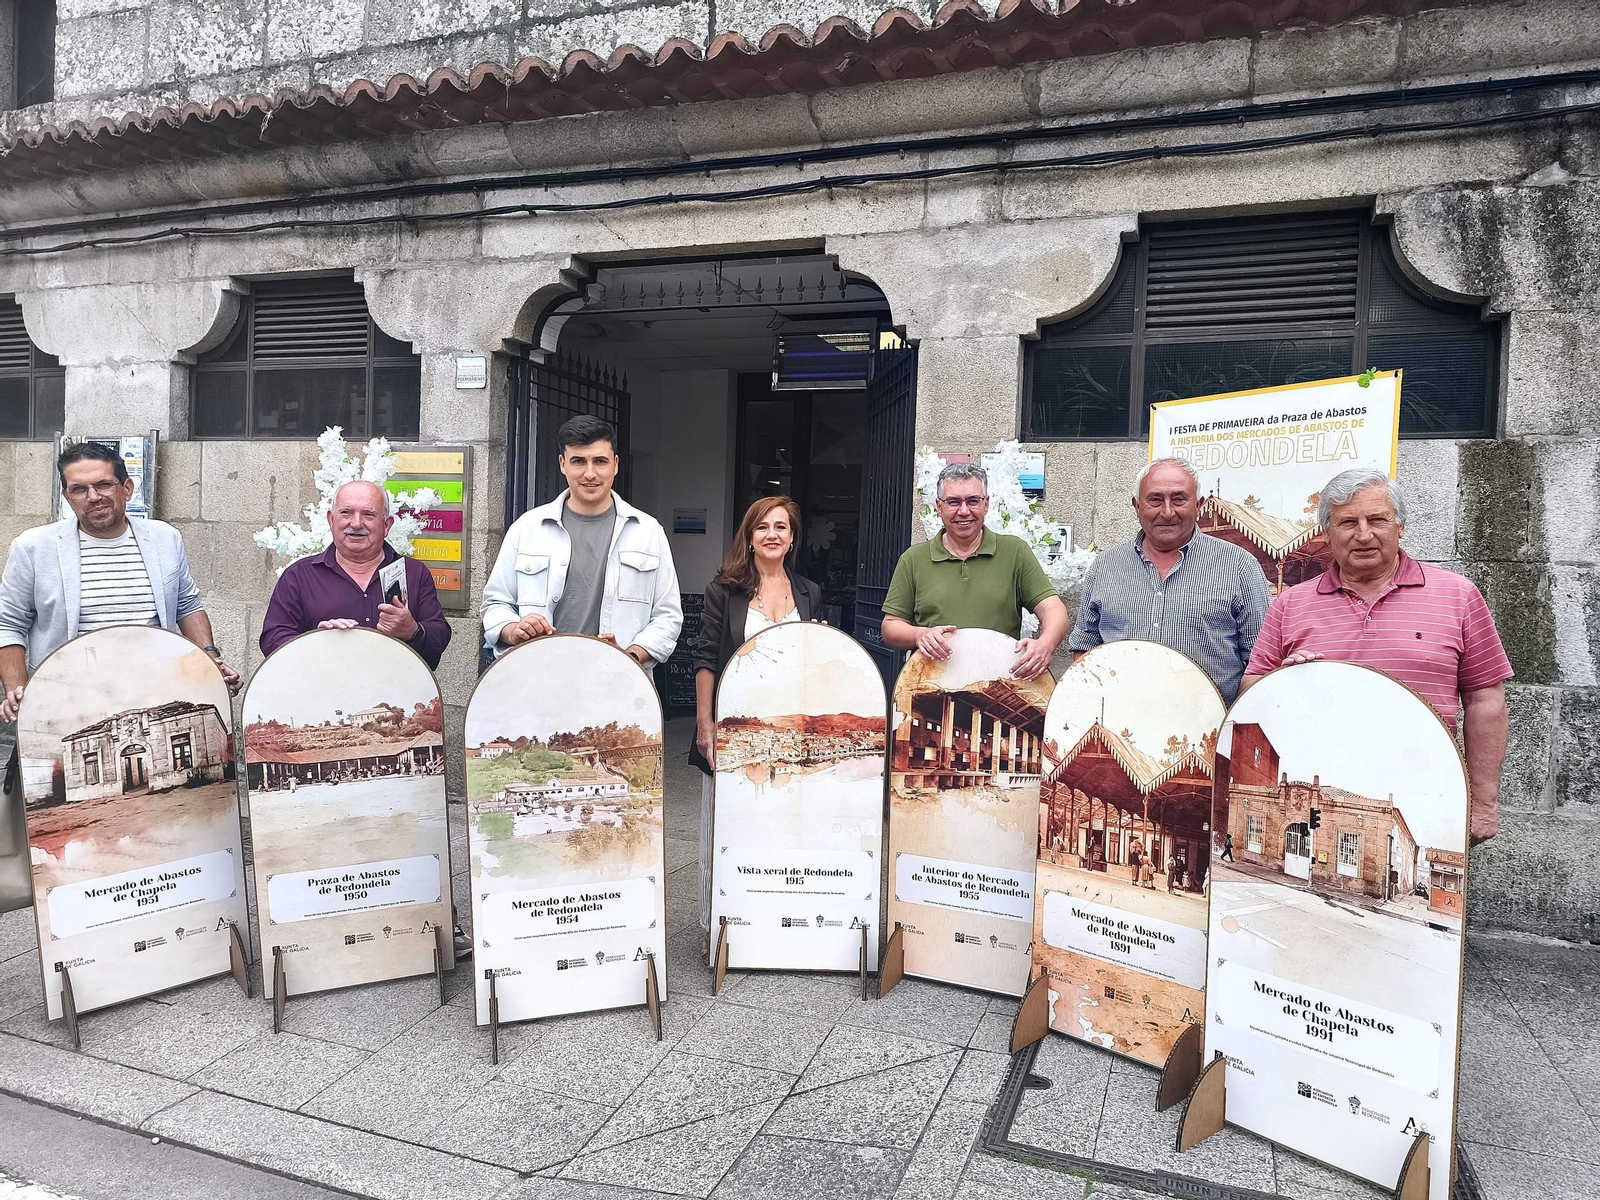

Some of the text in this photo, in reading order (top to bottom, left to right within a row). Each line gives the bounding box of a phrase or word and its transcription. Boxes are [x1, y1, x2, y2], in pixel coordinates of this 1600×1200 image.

[1169, 406, 1367, 435] I FESTA DE PRIMAVEIRA da Praza de Abastos
[1170, 418, 1365, 446] A HISTORIA DOS MERCADOS DE ABASTOS DE
[307, 868, 401, 887] Praza de Abastos
[737, 866, 853, 878] Vista xeral de Redondela
[785, 876, 805, 885] 1915
[922, 865, 1019, 888] Interior do Mercado
[84, 865, 202, 900] Mercado de Abastos
[318, 879, 391, 895] de Redondela
[912, 873, 1030, 899] de Abastos de Redondela
[113, 881, 177, 903] de Chapela
[136, 894, 160, 908] 1951
[344, 891, 368, 901] 1950
[511, 890, 621, 910] Mercado de Abastos
[959, 890, 980, 901] 1955
[530, 902, 603, 918] de Redondela
[215, 917, 224, 932] A
[420, 920, 429, 934] A
[555, 914, 579, 925] 1954
[849, 916, 858, 929] A
[1071, 907, 1176, 944] Mercado de Abastos
[1087, 924, 1156, 950] de Redondela
[633, 947, 643, 962] A
[1110, 941, 1131, 954] 1891
[1180, 1008, 1191, 1023] A
[1253, 980, 1395, 1035] Mercado de Abastos
[1282, 1004, 1359, 1037] de Chapela
[1305, 1024, 1334, 1043] 1991
[1400, 1117, 1416, 1135] A
[1166, 1178, 1211, 1196] UNION
